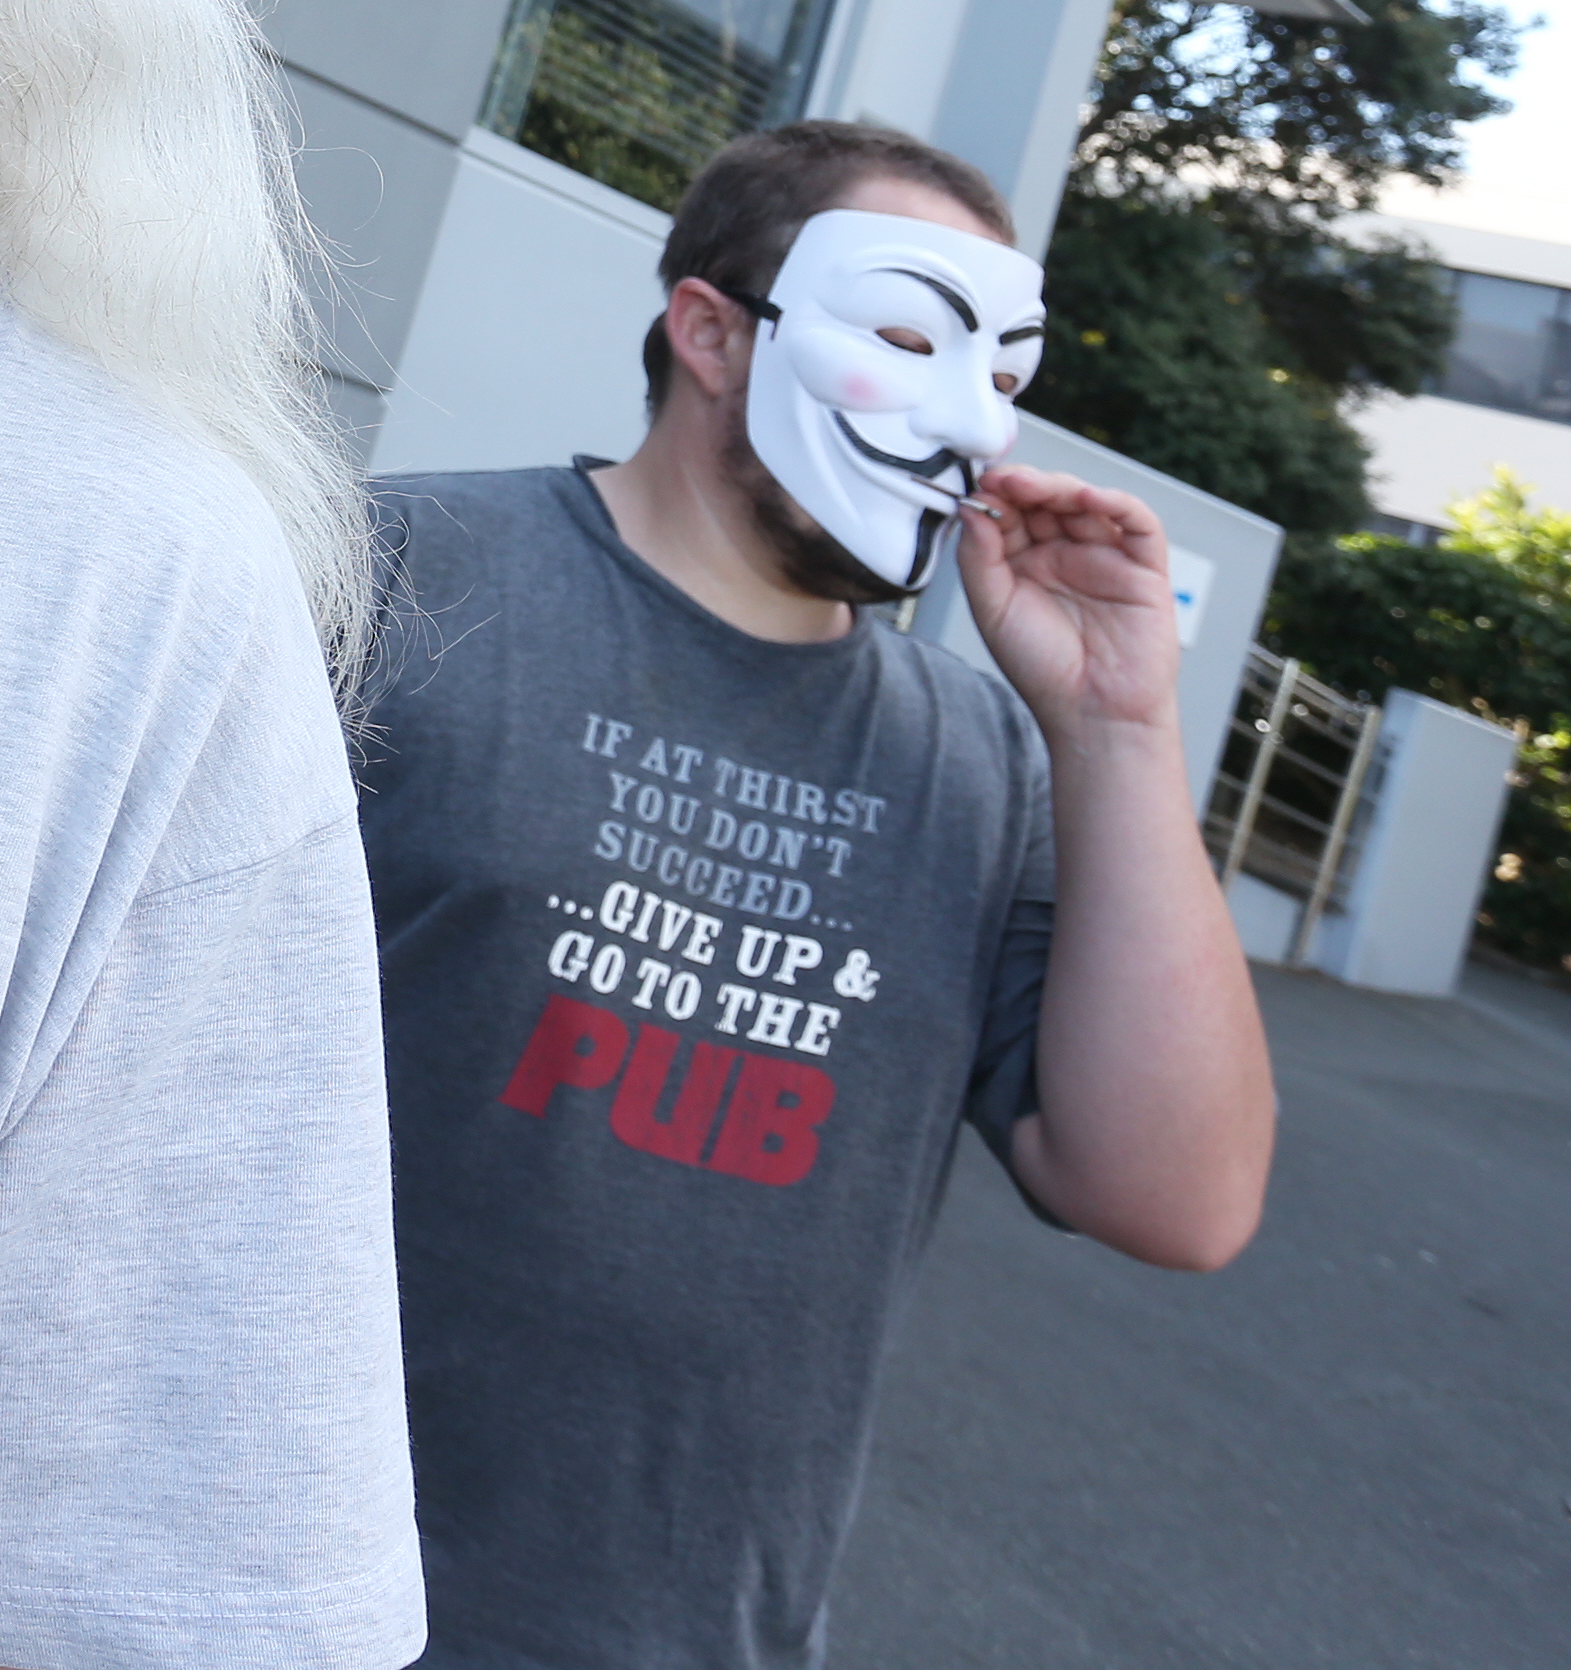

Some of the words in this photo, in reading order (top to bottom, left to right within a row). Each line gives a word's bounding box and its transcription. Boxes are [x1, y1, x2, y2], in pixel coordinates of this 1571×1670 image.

[581, 712, 634, 759] IF
[639, 736, 704, 785] AT
[711, 756, 887, 835] THIRST
[608, 770, 703, 836] YOU
[704, 808, 853, 878] DON'T
[593, 820, 855, 932] SUCCEED...
[547, 929, 627, 995] GO
[631, 957, 703, 1022] TO
[713, 982, 842, 1057] THE
[735, 924, 824, 987] UP
[831, 947, 881, 1003] &
[496, 991, 838, 1188] PUB
